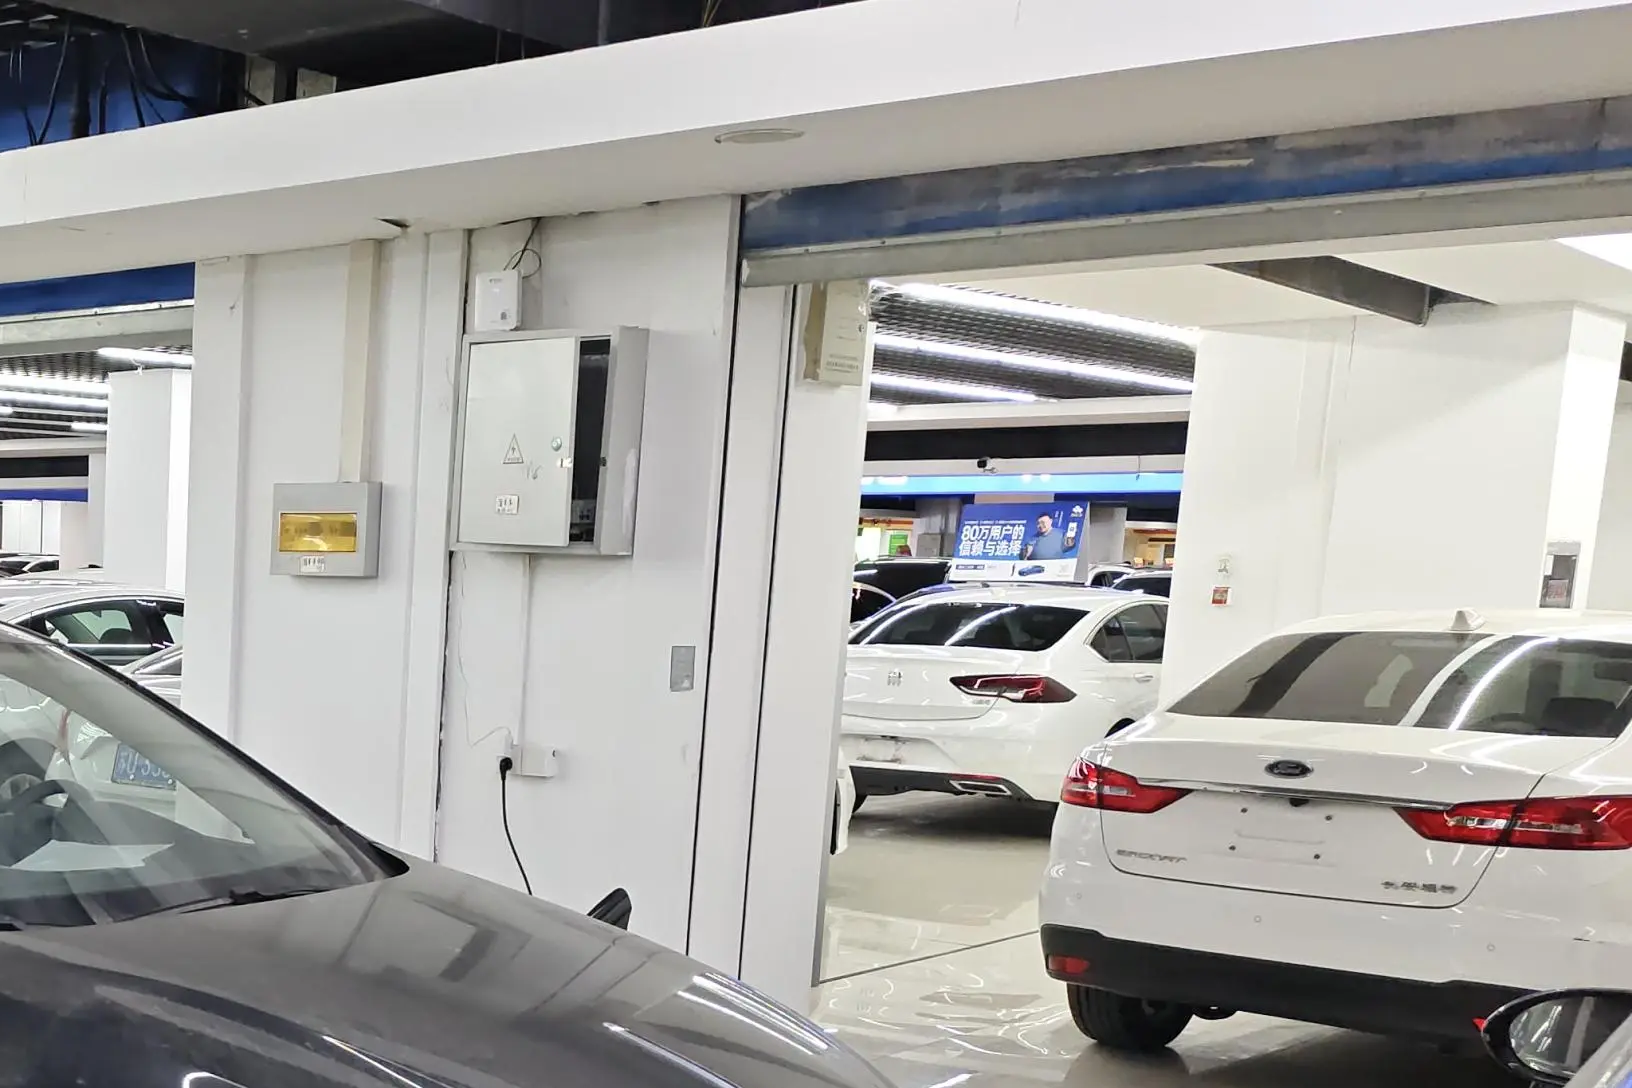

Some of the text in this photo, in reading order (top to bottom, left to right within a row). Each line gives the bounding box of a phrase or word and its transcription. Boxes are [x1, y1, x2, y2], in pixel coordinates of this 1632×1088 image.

[961, 524, 1025, 540] 80万用户的
[959, 540, 1022, 556] 信赖与选择
